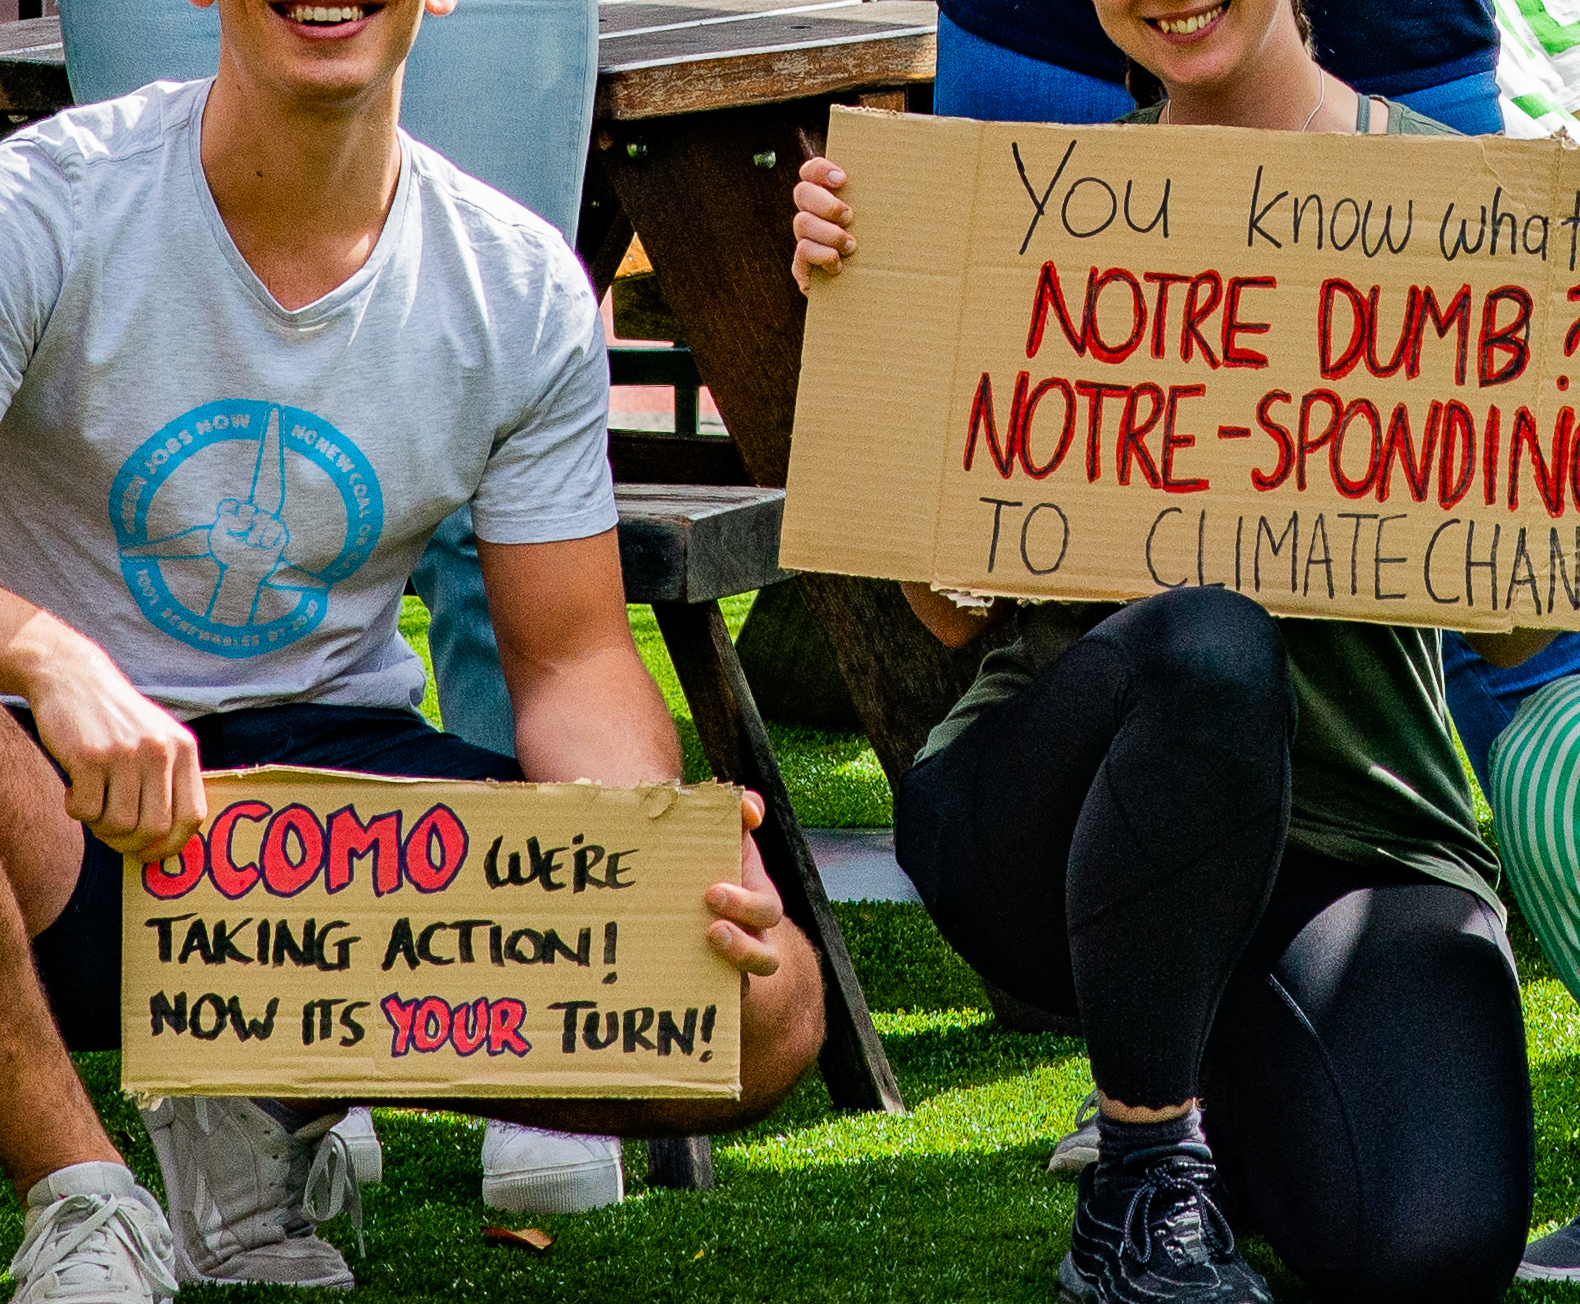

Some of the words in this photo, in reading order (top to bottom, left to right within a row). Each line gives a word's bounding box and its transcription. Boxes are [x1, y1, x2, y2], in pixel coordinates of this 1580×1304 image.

[1012, 139, 1173, 256] You
[1247, 165, 1414, 259] know
[1024, 260, 1278, 371] NOTRE
[144, 429, 194, 475] JOBS
[196, 414, 251, 435] NOW
[291, 424, 317, 445] NO
[314, 438, 355, 473] NEW
[349, 473, 372, 519] COAL
[979, 497, 1071, 578] TO
[1144, 505, 1410, 603] CLIMATE
[483, 833, 639, 893] WE'RE
[143, 912, 362, 971] TAKING
[381, 916, 618, 984] ACTION!
[150, 989, 280, 1043] NOW
[301, 998, 370, 1047] ITS
[379, 992, 532, 1058] YOUR
[546, 999, 718, 1063] TURN!
